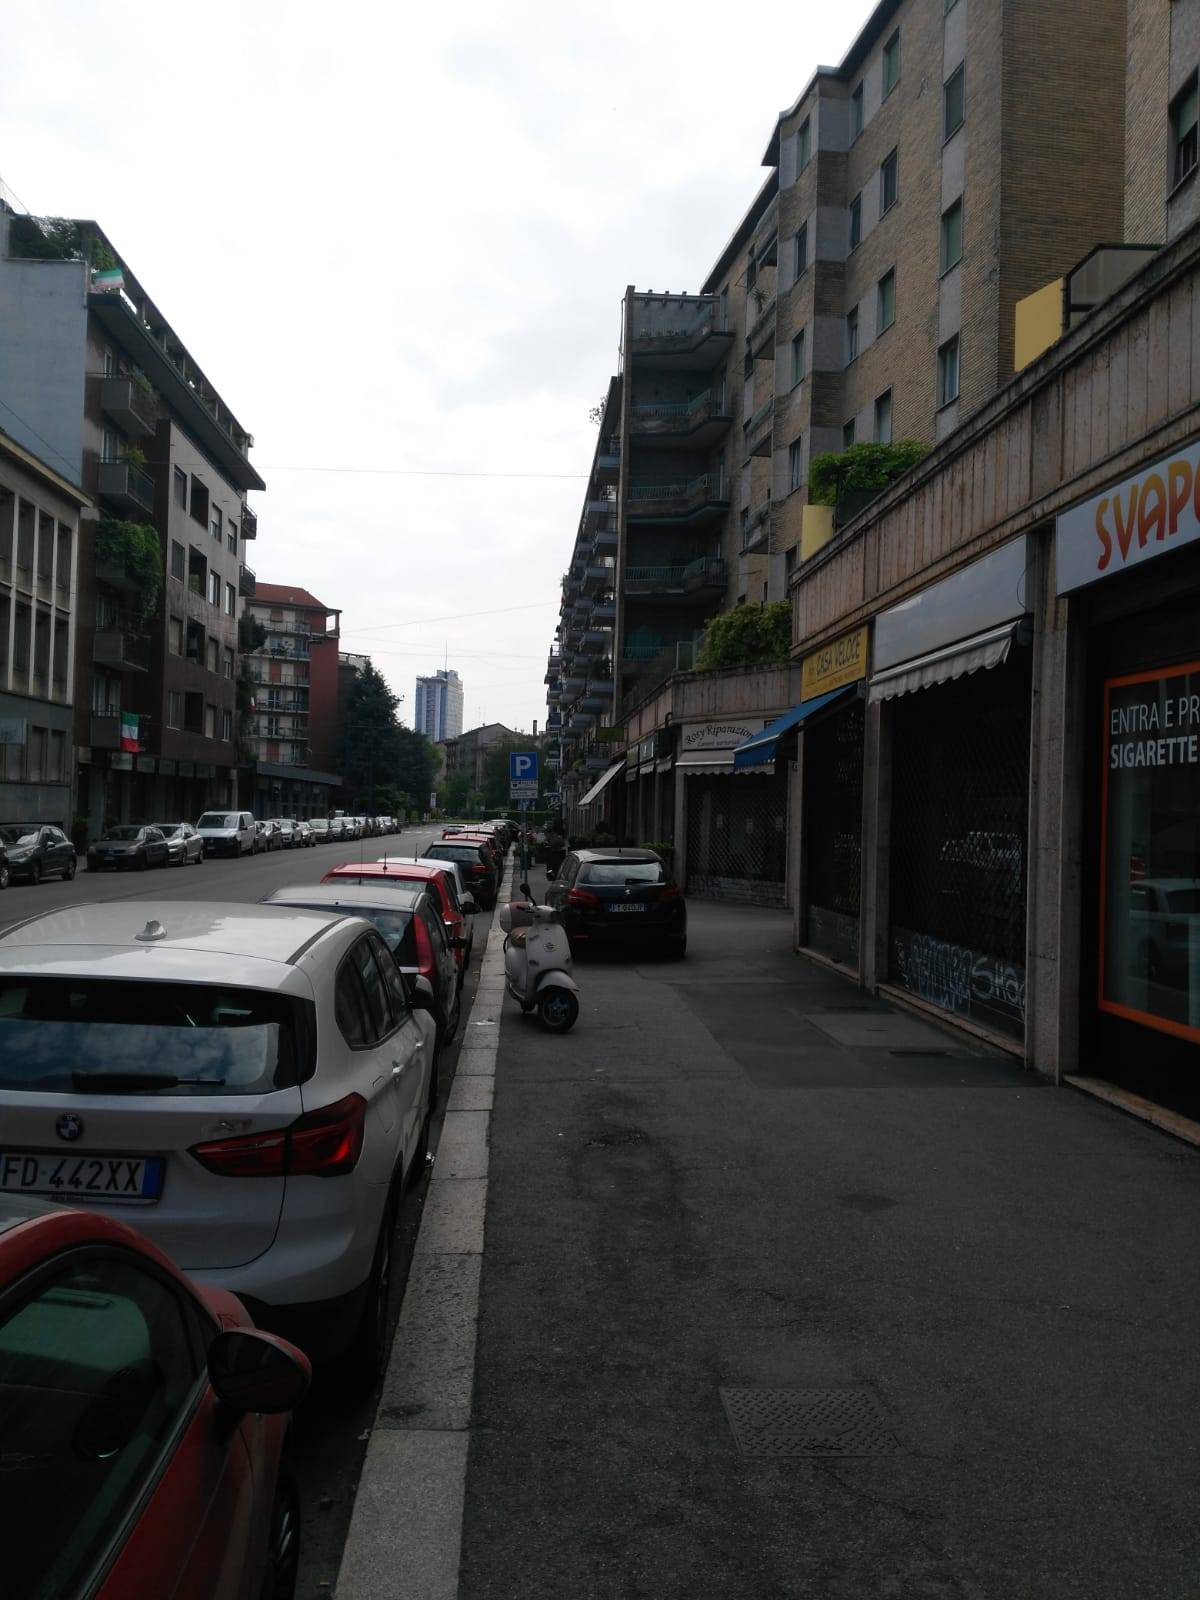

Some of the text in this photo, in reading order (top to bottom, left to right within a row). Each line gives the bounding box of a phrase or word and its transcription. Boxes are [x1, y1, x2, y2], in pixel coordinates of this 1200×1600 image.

[1111, 702, 1160, 735] ENTRA
[1165, 699, 1174, 728] E
[515, 756, 532, 777] P
[1111, 735, 1198, 769] SIGARETTE
